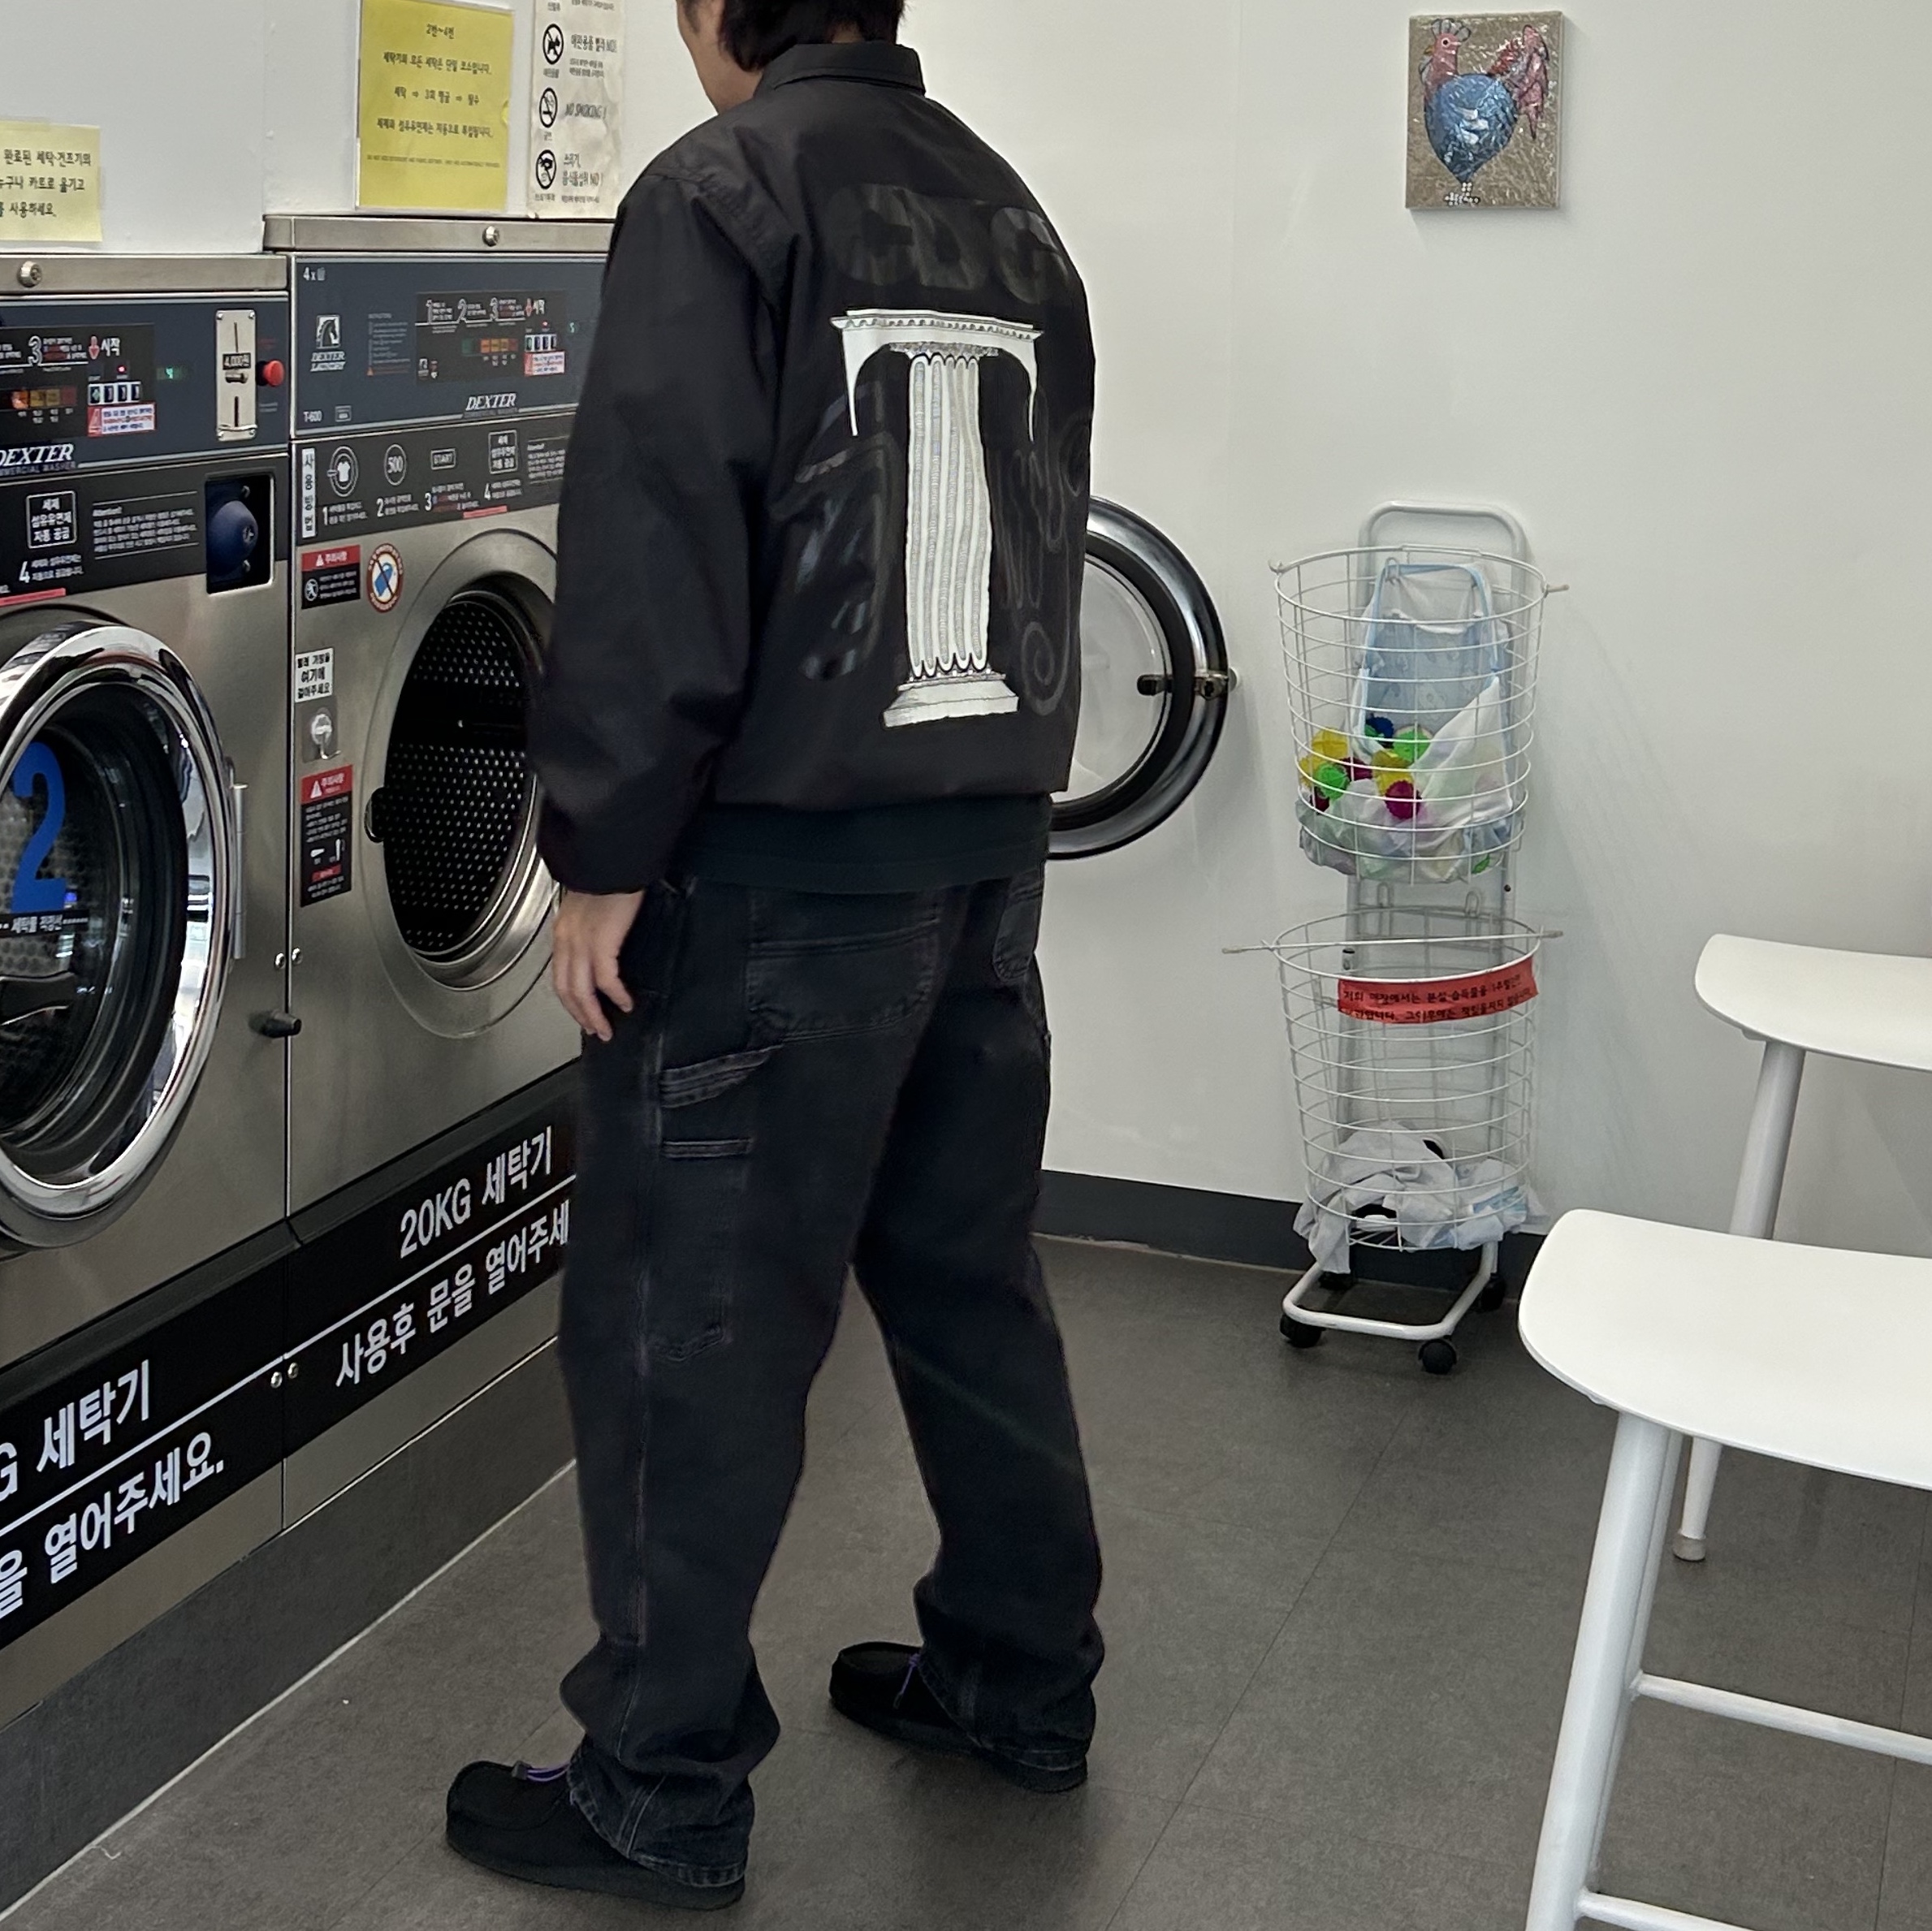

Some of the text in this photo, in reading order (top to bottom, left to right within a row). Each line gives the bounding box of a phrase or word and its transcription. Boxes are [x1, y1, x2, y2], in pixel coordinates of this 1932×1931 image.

[4, 149, 32, 166] 완료된
[28, 335, 42, 366] 3
[101, 337, 121, 357] 시작
[465, 392, 516, 411] DEXTER
[387, 456, 404, 473] 500
[376, 498, 384, 517] 2
[425, 492, 432, 512] 3
[19, 560, 30, 583] 4
[11, 741, 67, 914] 2
[400, 1125, 552, 1259] 20KG 세탁기
[335, 1302, 417, 1387] 사용후
[427, 1263, 477, 1333] 문을
[37, 1359, 149, 1472] 세탁기
[45, 1432, 224, 1584] 열어주세요.
